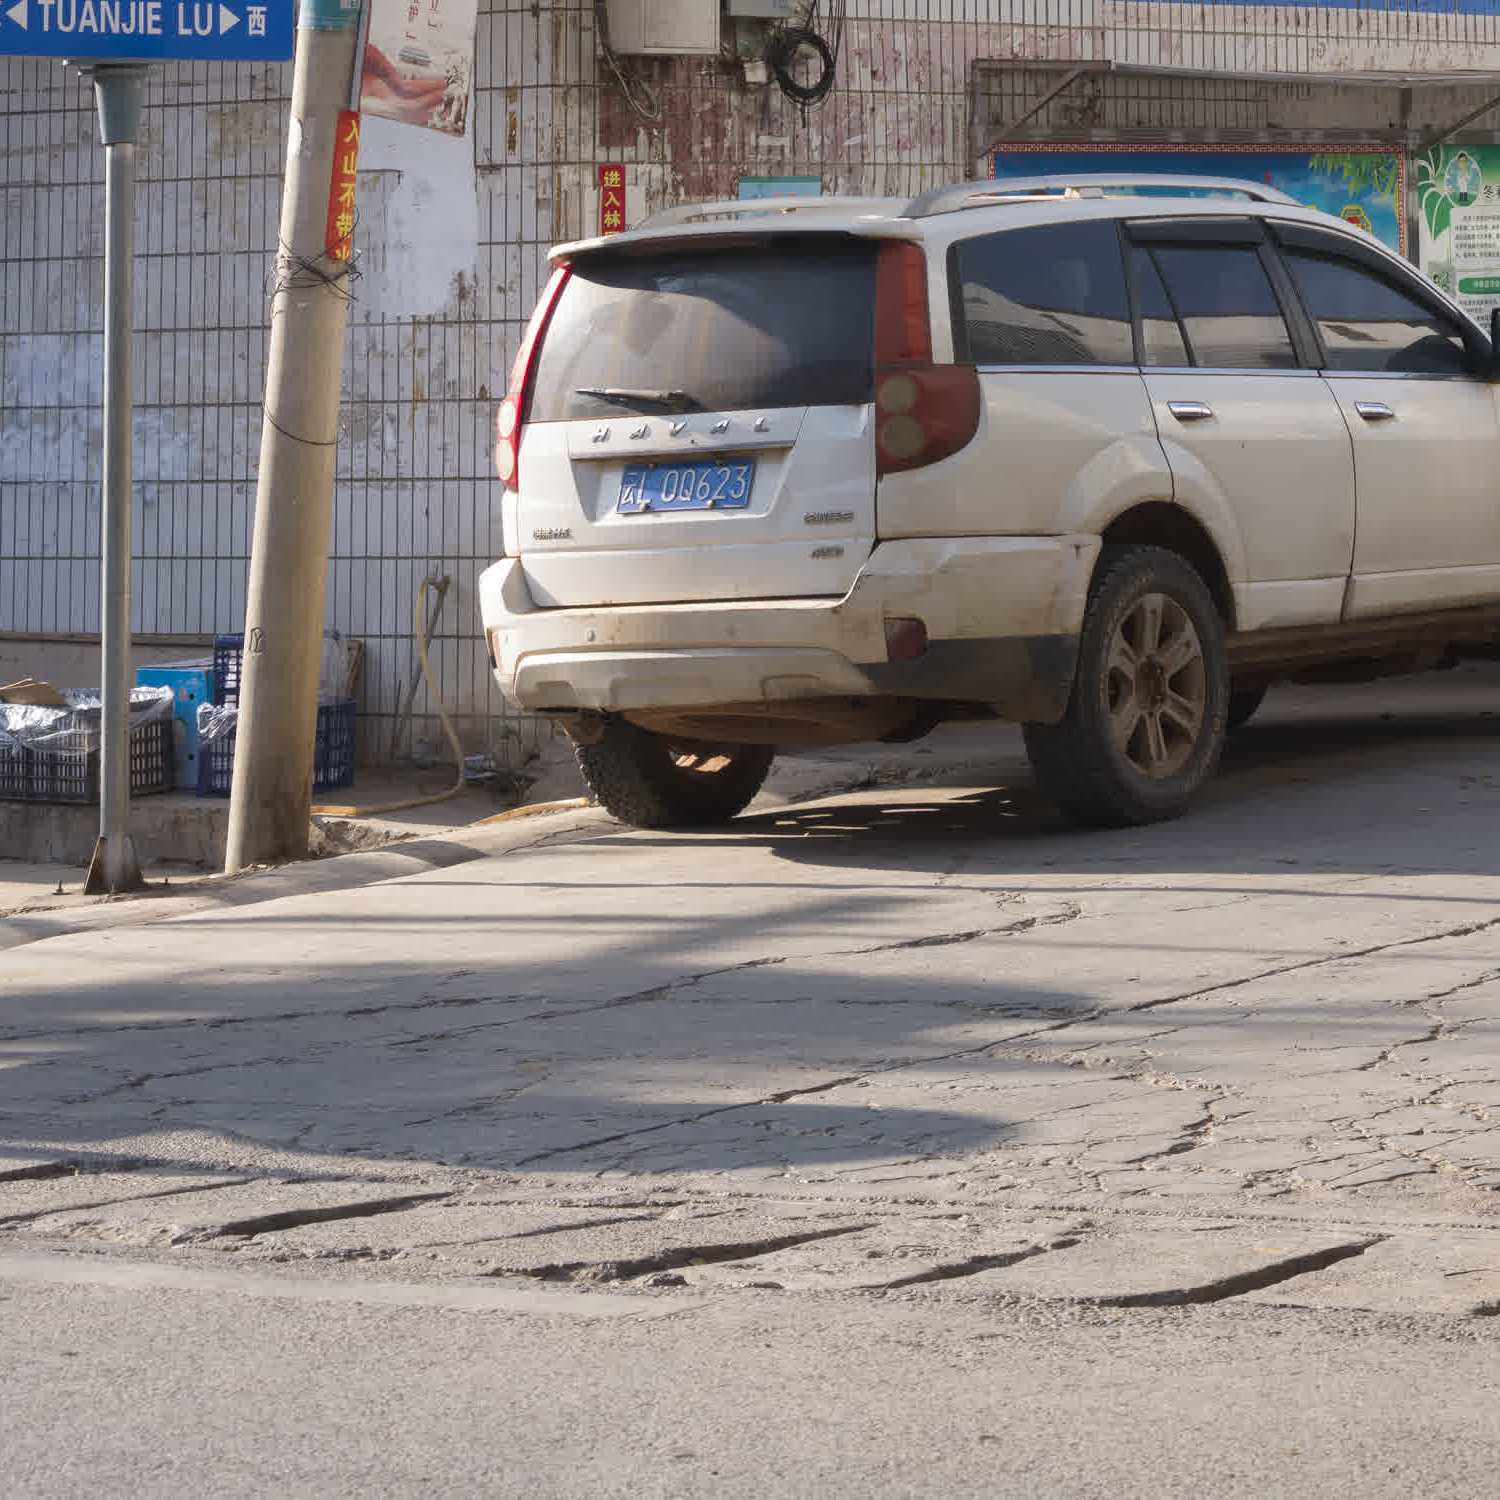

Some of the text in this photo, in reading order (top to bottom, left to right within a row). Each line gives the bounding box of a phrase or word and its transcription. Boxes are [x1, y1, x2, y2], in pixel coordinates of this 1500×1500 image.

[177, 2, 213, 36] LU
[246, 5, 268, 36] 西
[603, 170, 621, 236] 进入林
[592, 415, 771, 443] HAVAL
